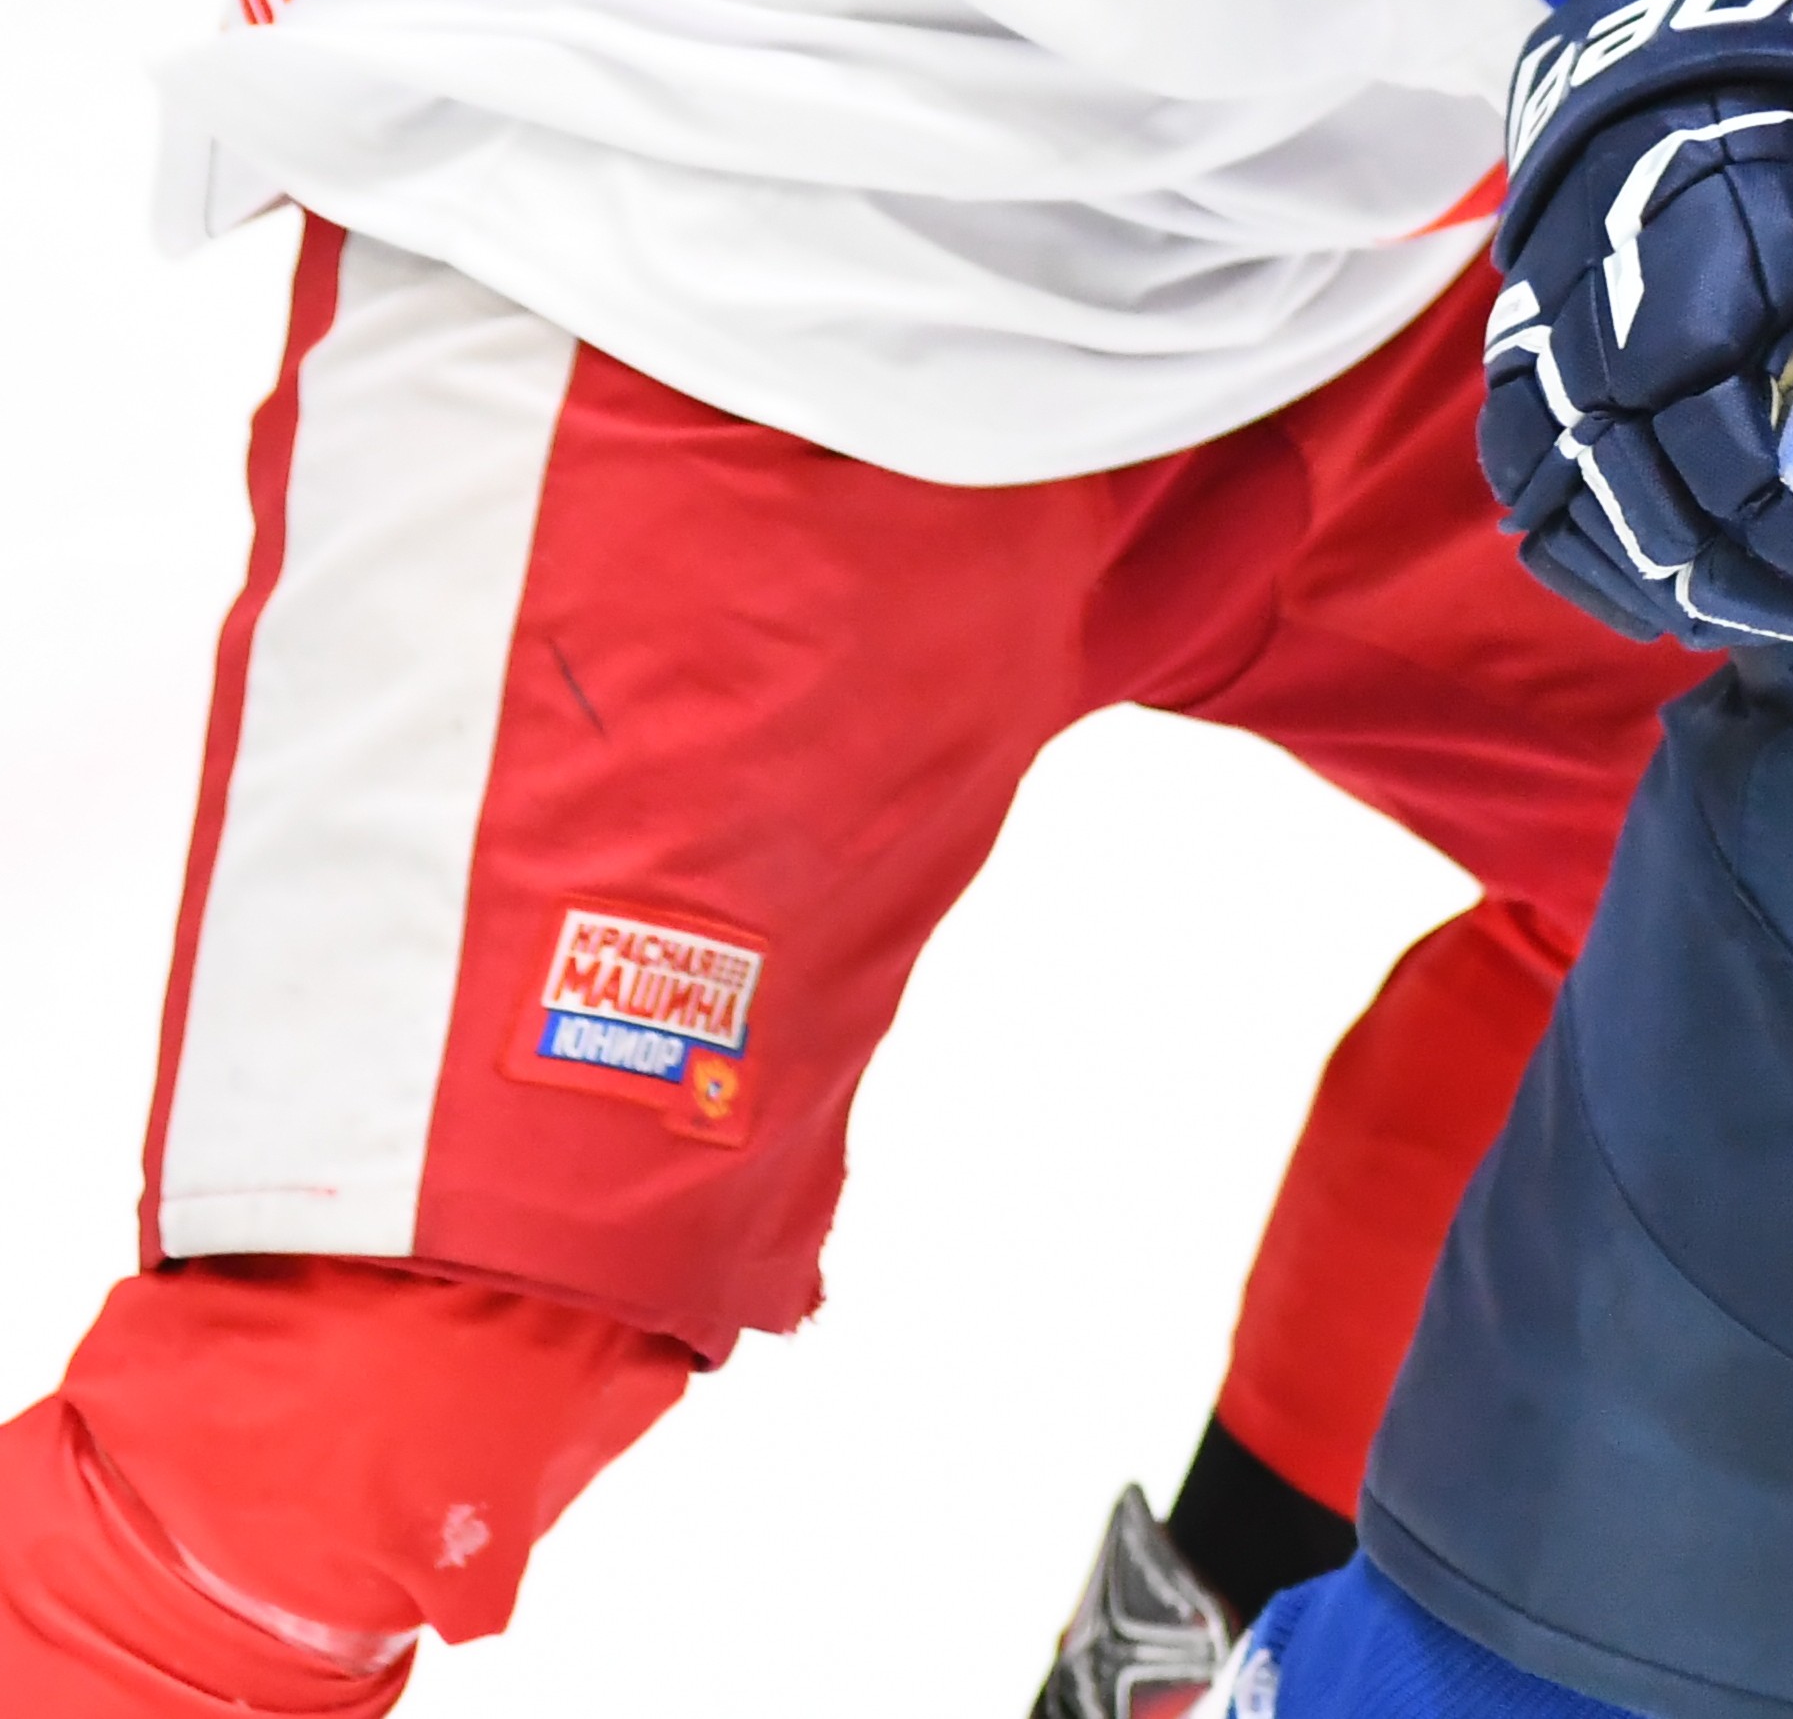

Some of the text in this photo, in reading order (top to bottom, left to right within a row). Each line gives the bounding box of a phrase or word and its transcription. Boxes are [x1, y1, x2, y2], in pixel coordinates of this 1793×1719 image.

[569, 922, 718, 980] КРАСНАЯ
[554, 955, 739, 1039] МАШИНА
[552, 1014, 684, 1076] ЮНИОР
